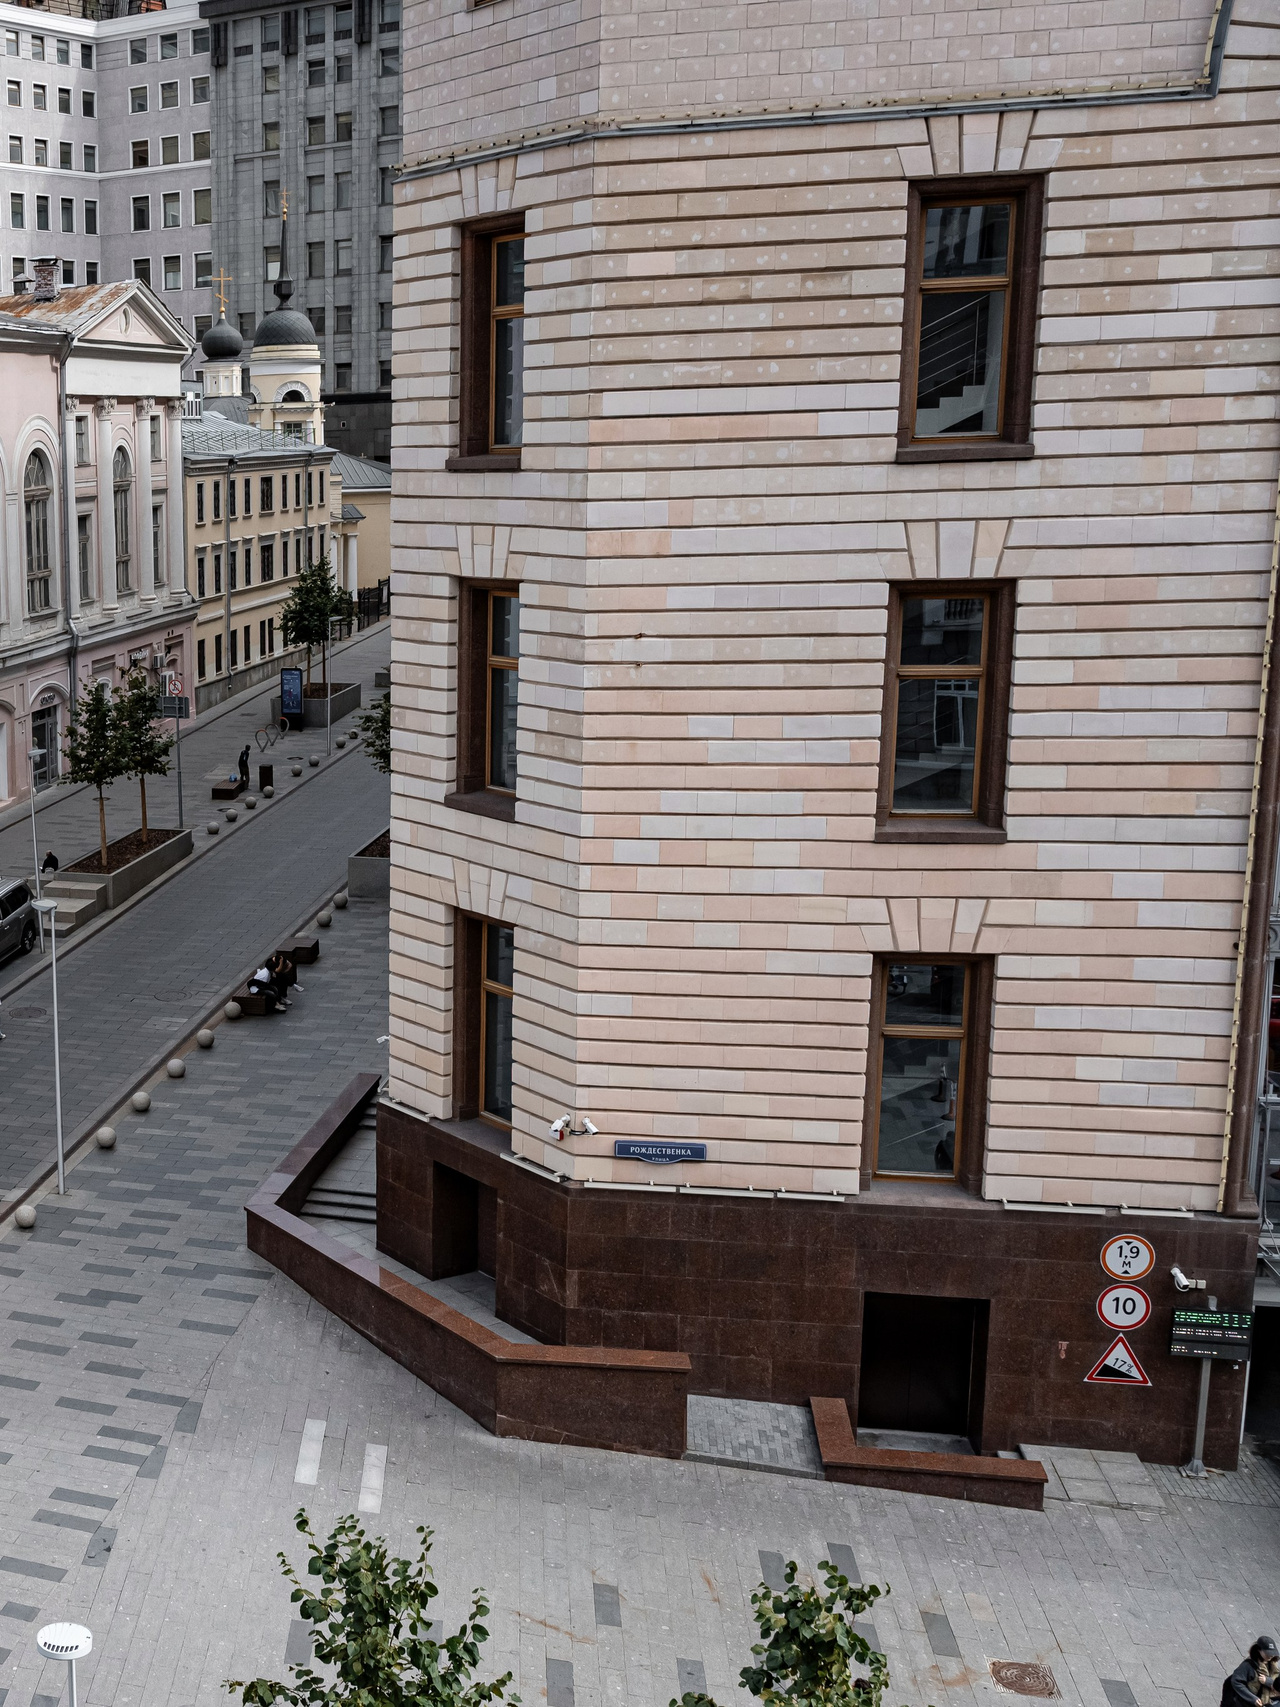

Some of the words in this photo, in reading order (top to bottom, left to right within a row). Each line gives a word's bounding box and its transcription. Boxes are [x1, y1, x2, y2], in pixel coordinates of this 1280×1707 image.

[630, 1146, 691, 1156] РОЖДЕСТВЕНКА
[1117, 1245, 1140, 1260] 1,9
[1112, 1296, 1136, 1315] 10
[1113, 1357, 1134, 1374] 17%
